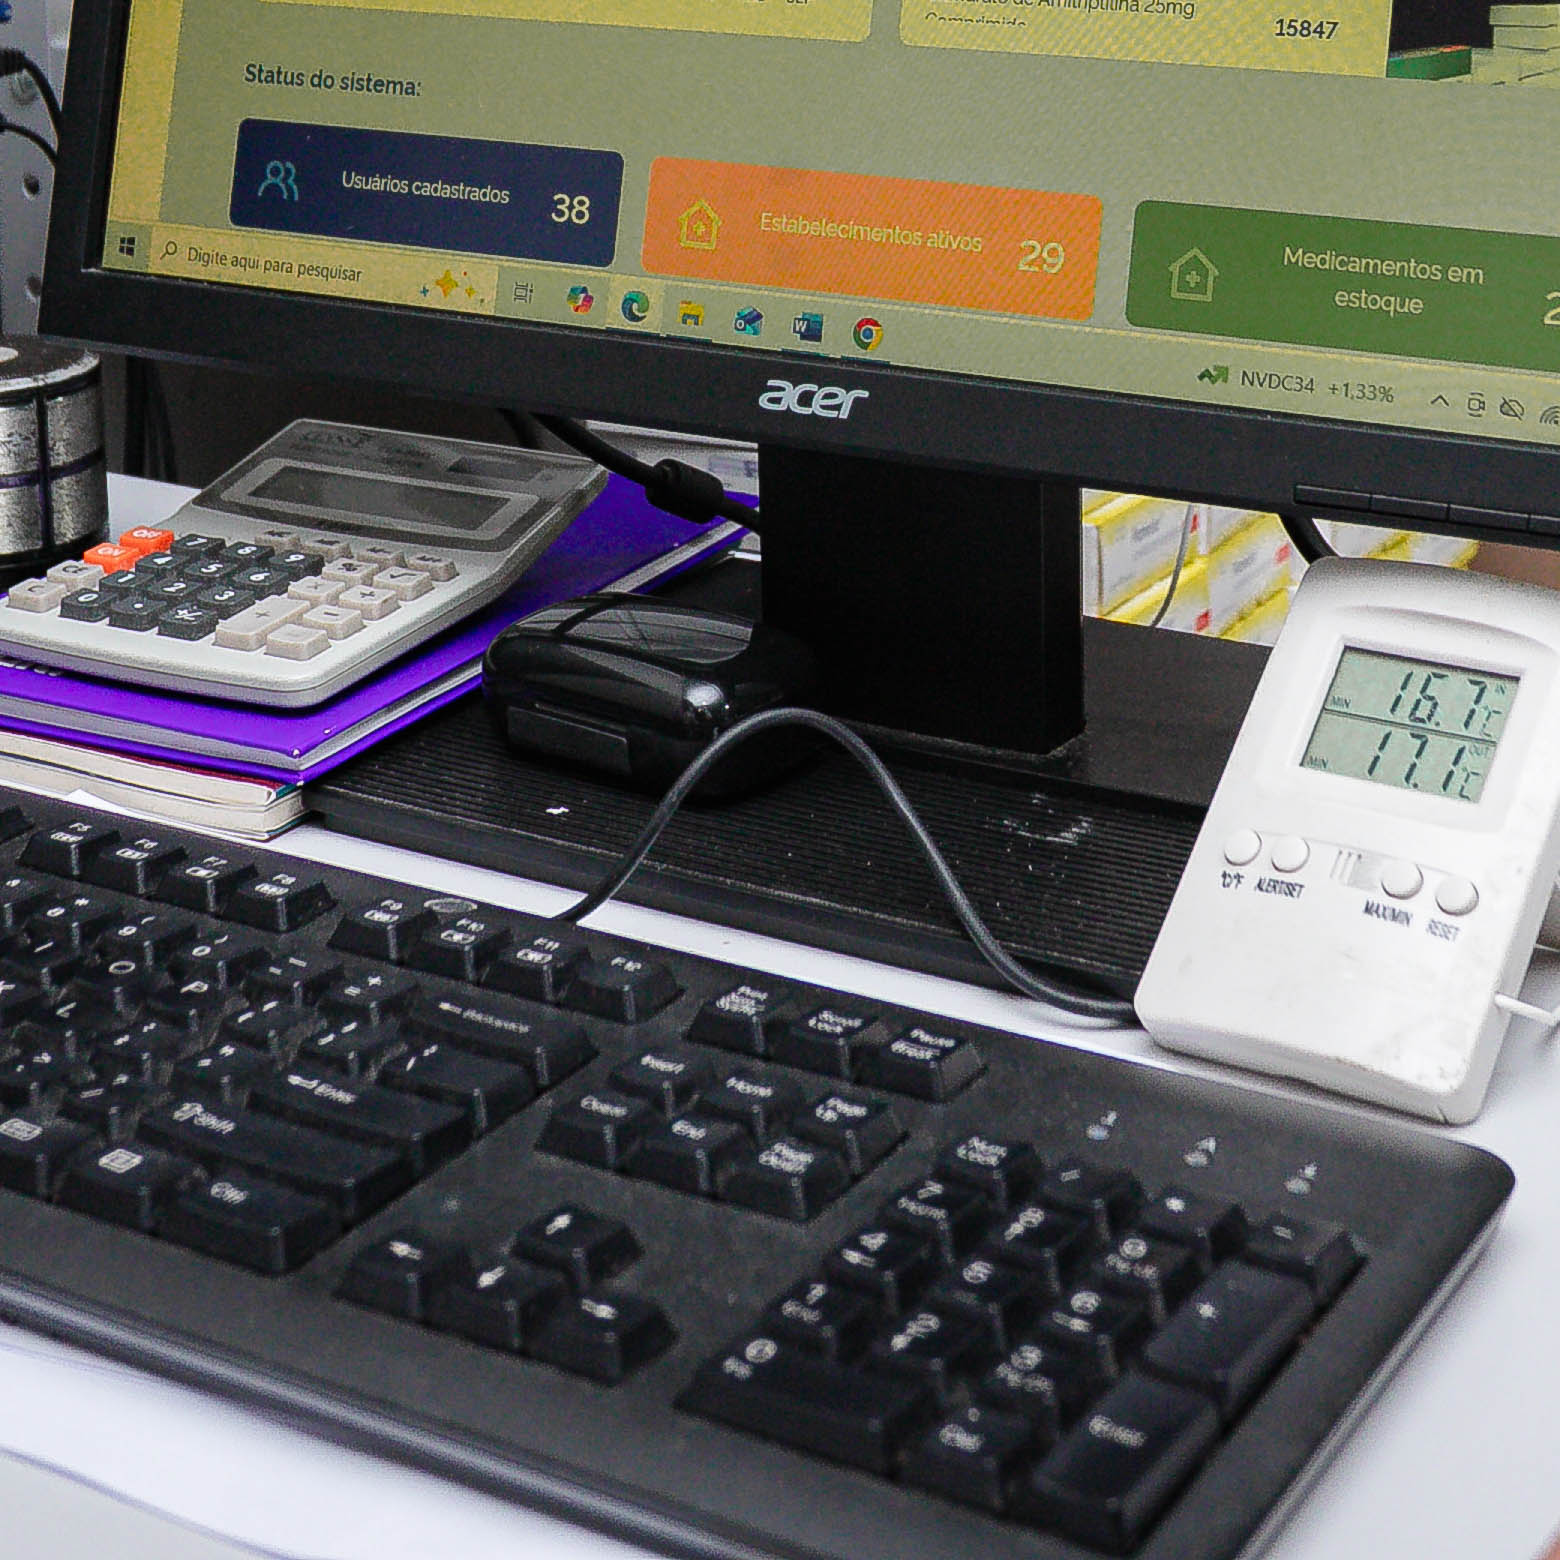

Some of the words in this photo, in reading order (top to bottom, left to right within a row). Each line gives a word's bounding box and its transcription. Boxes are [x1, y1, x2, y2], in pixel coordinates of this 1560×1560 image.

[1274, 18, 1340, 40] 15847
[244, 63, 306, 89] Status
[310, 70, 335, 90] do
[339, 72, 423, 98] sistema:
[341, 171, 409, 195] Usuários
[412, 180, 511, 206] cadastrados
[551, 193, 590, 225] 38
[760, 212, 922, 247] Estabelecimentos
[926, 231, 983, 253] ativos
[187, 246, 228, 269] Digite
[231, 252, 260, 273] aqui
[263, 257, 294, 278] para
[296, 260, 362, 283] pesquisar
[1017, 240, 1065, 275] 29
[1282, 245, 1443, 283] Medicamentos
[1447, 262, 1484, 285] em
[1335, 288, 1424, 316] estoque
[1241, 370, 1315, 394] NVDC34
[758, 378, 869, 420] acer
[237, 546, 257, 556] 8
[116, 573, 136, 584] 1
[200, 563, 224, 574] 5
[77, 593, 98, 604] 0
[163, 581, 187, 593] 2
[214, 590, 235, 602] 3
[1389, 671, 1487, 730] 16.7
[1367, 730, 1466, 792] 17.1
